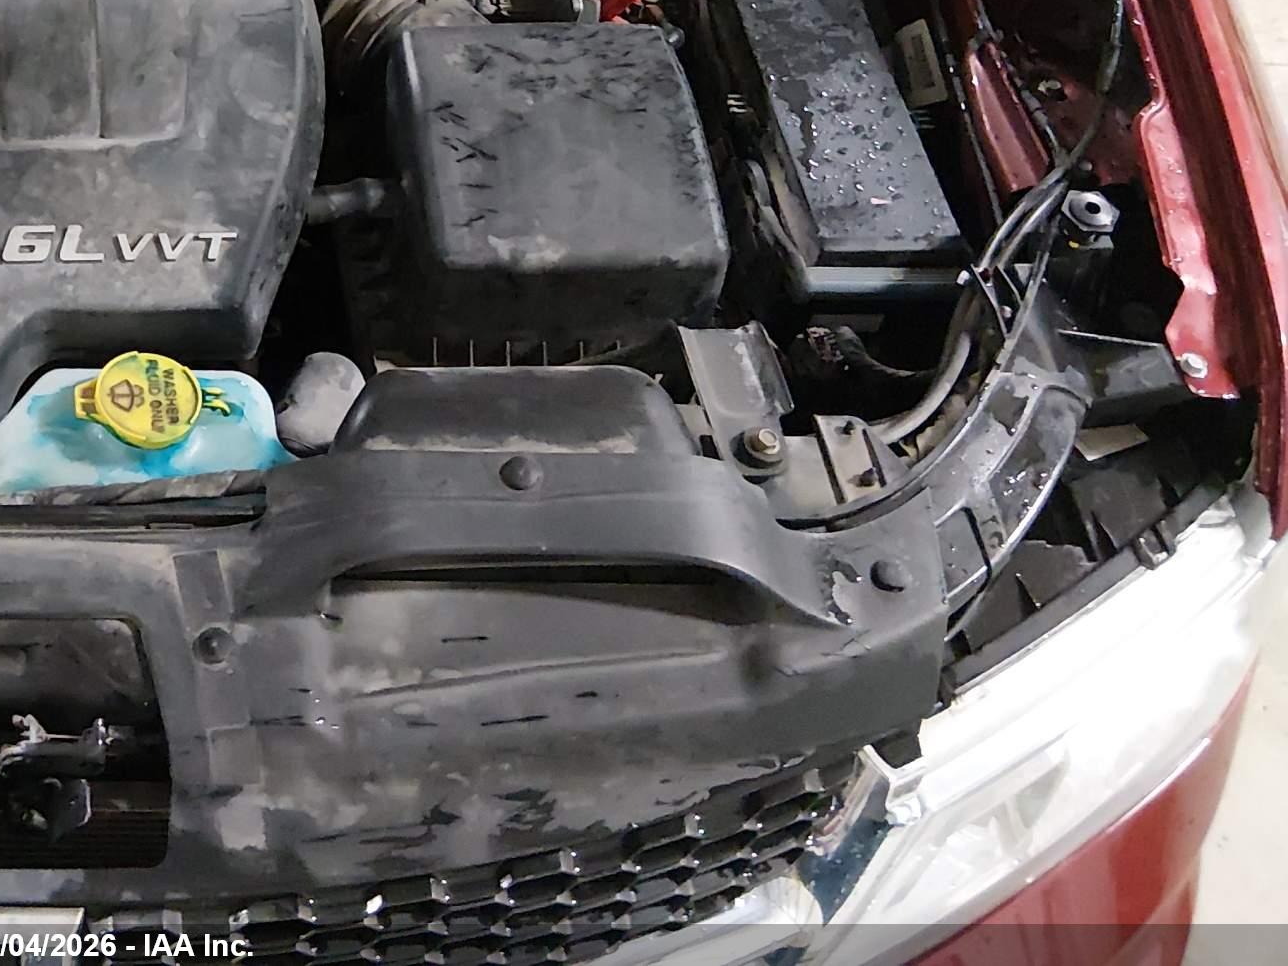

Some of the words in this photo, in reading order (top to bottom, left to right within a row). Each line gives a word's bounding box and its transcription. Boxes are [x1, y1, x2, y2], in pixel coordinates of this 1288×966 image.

[115, 232, 238, 262] VVT
[145, 359, 161, 396] FLUID
[162, 368, 180, 425] WASHER
[149, 399, 166, 433] ONLY
